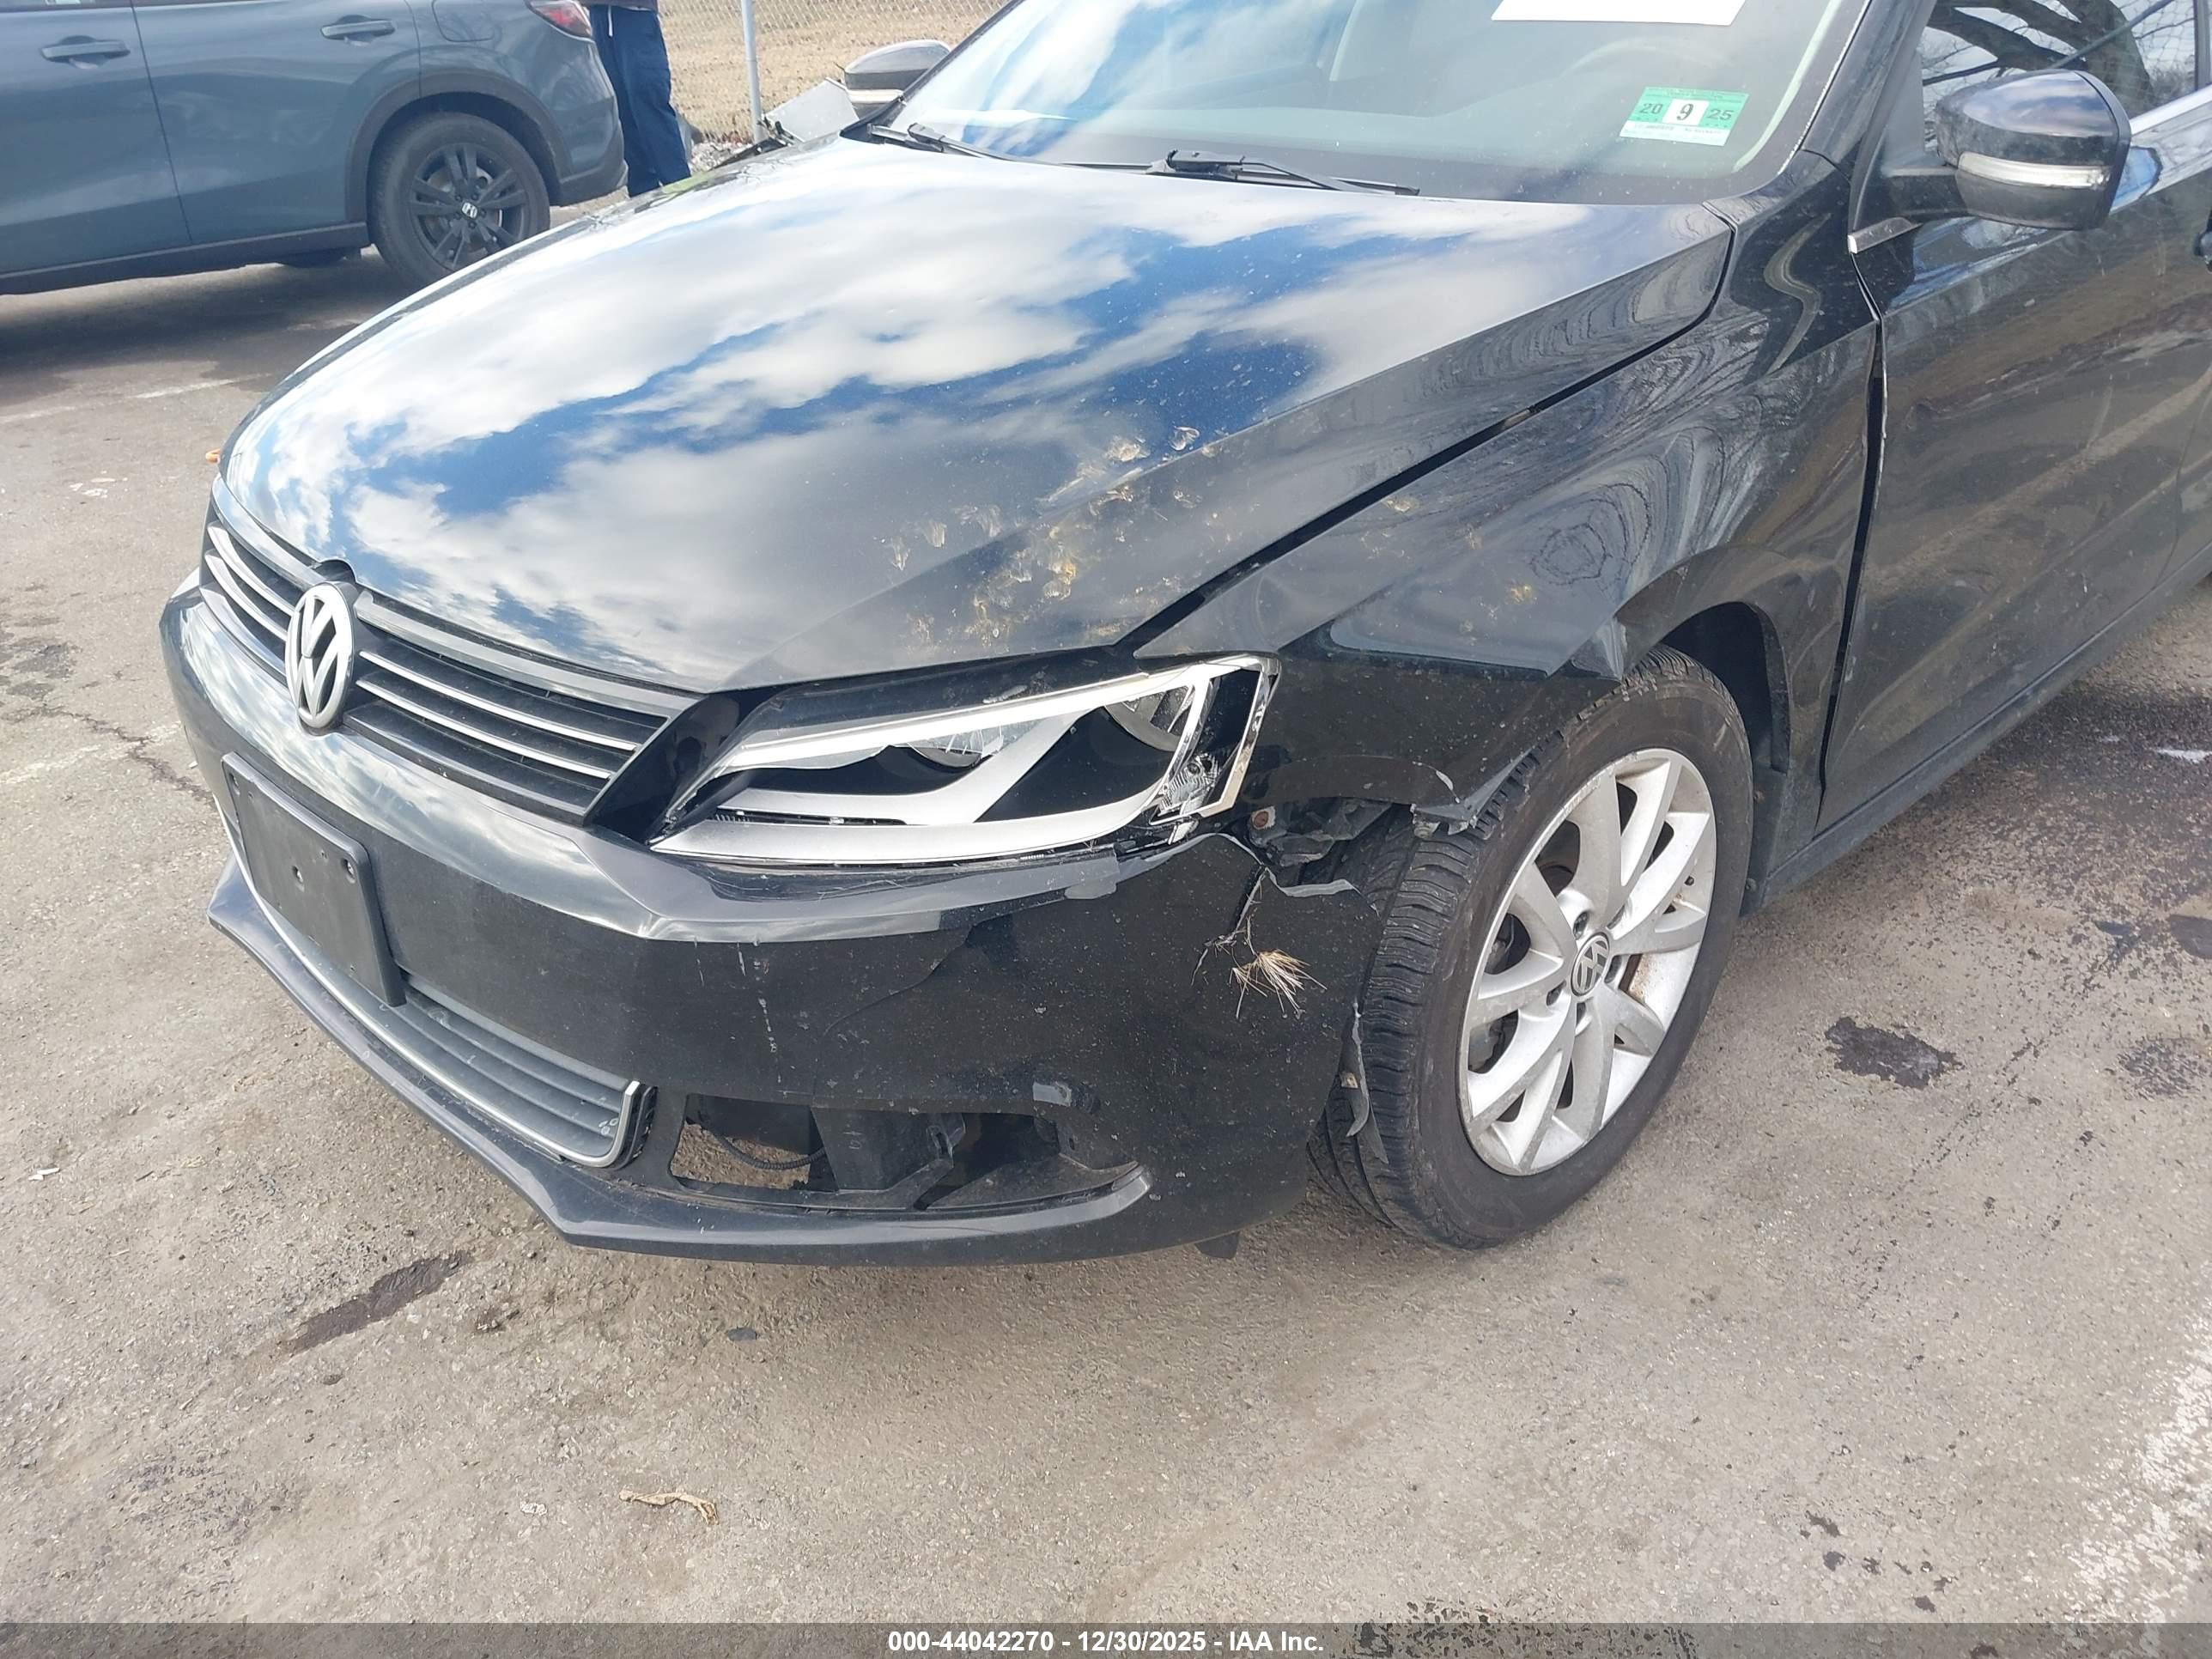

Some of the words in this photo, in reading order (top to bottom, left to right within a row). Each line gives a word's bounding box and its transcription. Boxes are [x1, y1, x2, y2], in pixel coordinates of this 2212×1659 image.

[1639, 102, 1663, 114] 20
[1676, 103, 1694, 121] 9
[1707, 108, 1735, 121] 25
